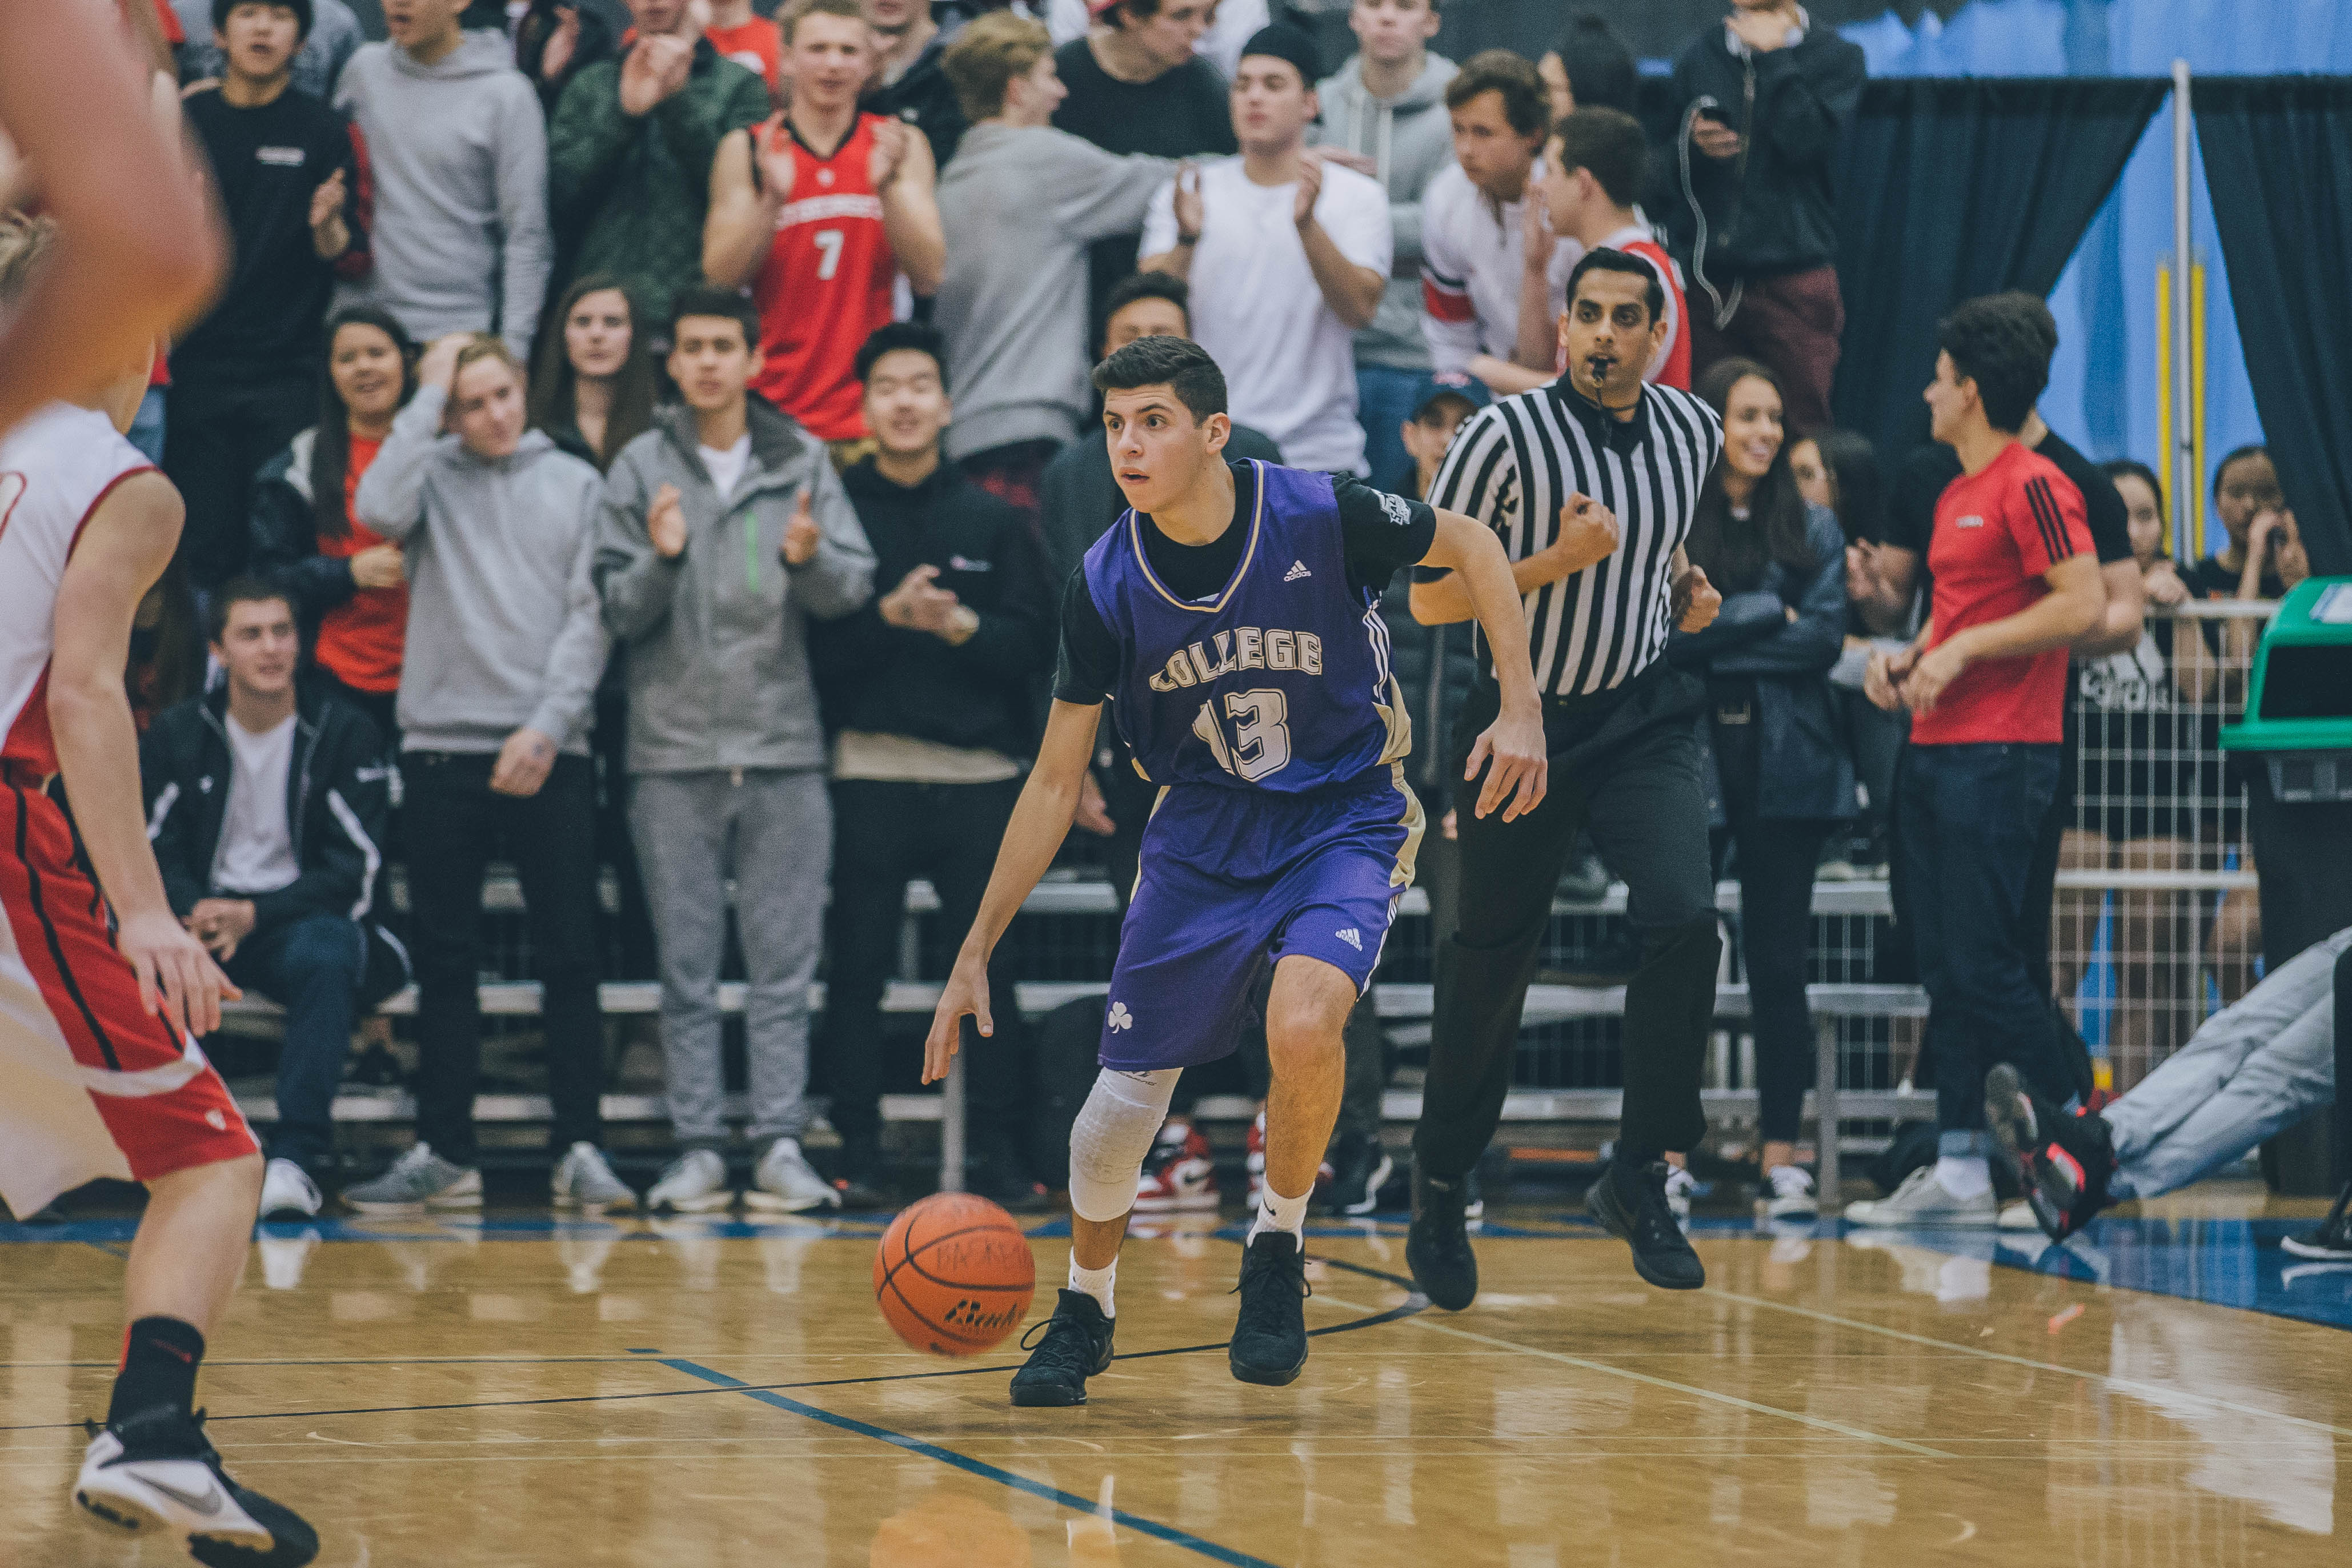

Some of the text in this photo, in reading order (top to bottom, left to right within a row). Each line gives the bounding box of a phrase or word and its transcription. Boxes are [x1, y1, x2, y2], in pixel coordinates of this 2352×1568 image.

[815, 230, 844, 280] 7
[1283, 571, 1312, 582] adidas
[1192, 688, 1291, 783] 13
